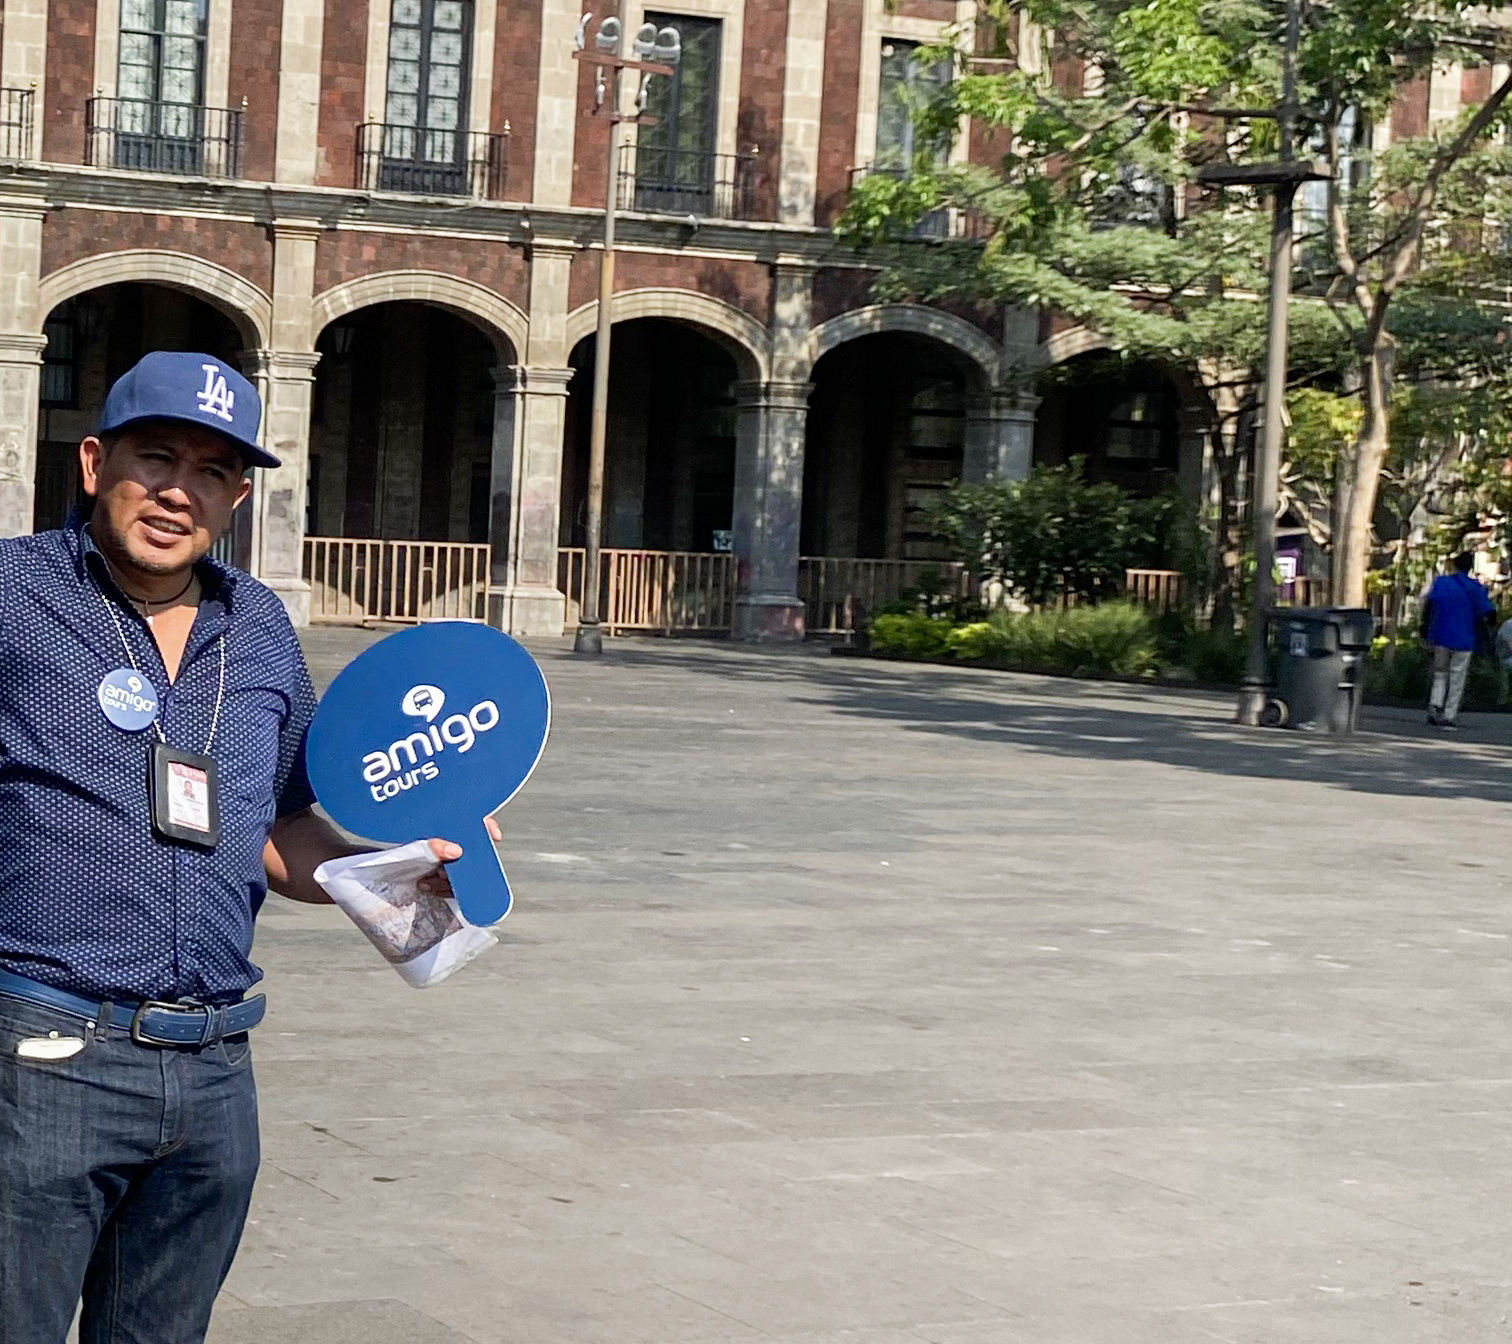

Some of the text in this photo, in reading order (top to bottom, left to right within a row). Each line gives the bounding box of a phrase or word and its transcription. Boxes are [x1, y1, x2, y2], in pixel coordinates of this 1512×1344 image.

[197, 363, 235, 423] LA
[104, 683, 154, 712] amigo
[361, 698, 501, 784] amigo
[369, 758, 440, 803] tours
